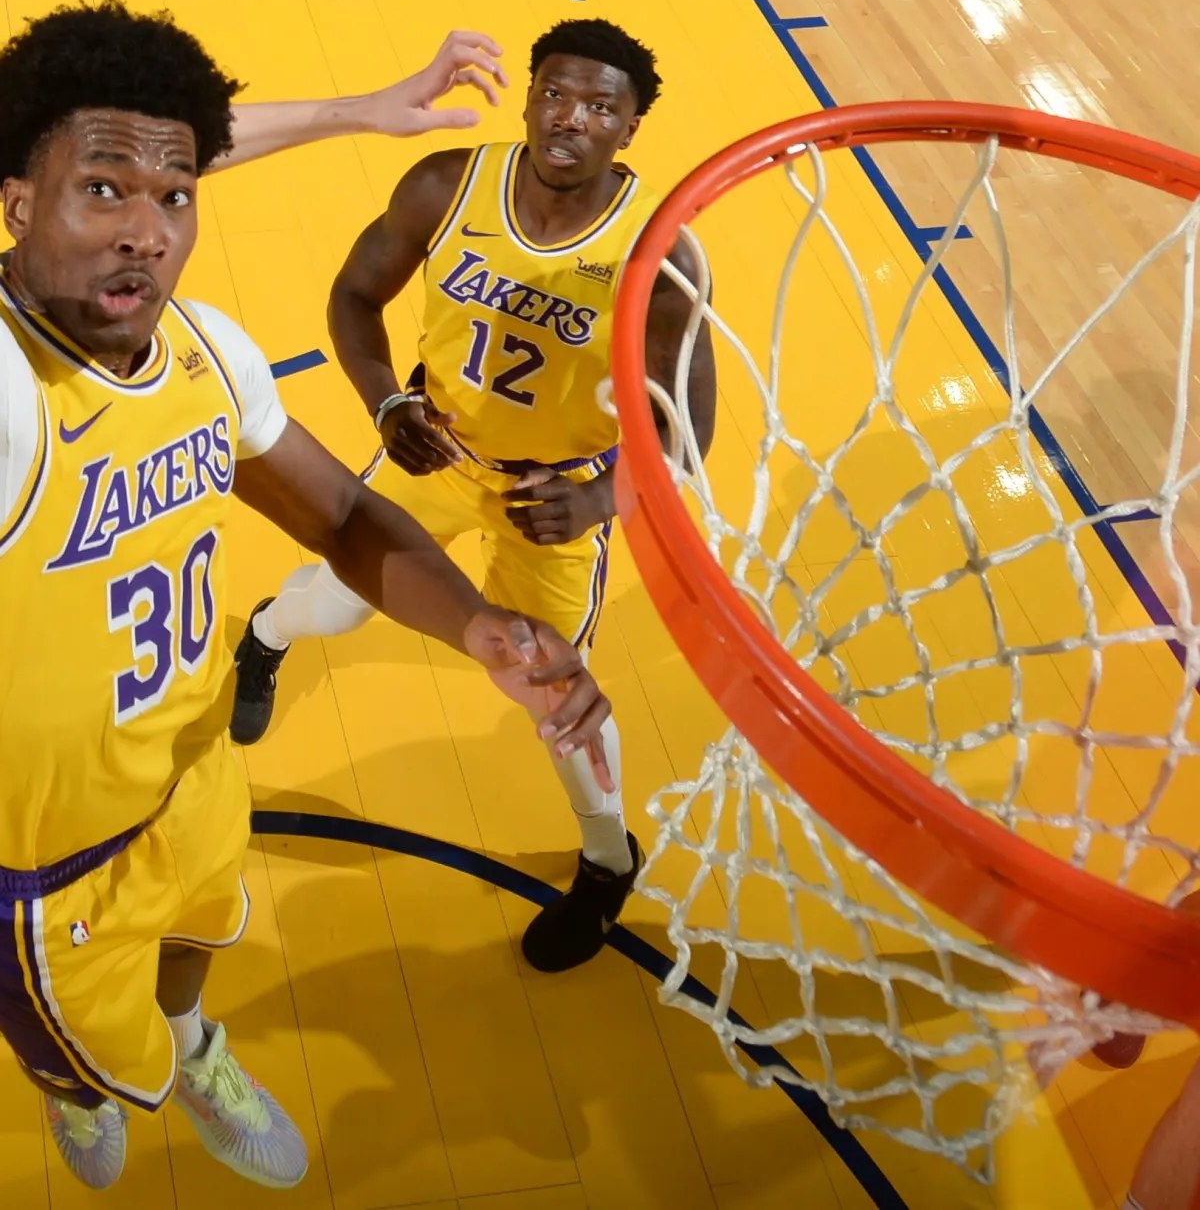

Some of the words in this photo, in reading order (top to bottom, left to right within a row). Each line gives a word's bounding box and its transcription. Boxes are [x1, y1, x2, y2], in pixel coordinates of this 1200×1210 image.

[438, 248, 597, 347] LAKERS
[577, 256, 613, 279] wish
[460, 318, 548, 412] 12
[42, 414, 236, 574] LAKERS
[107, 526, 220, 728] 30
